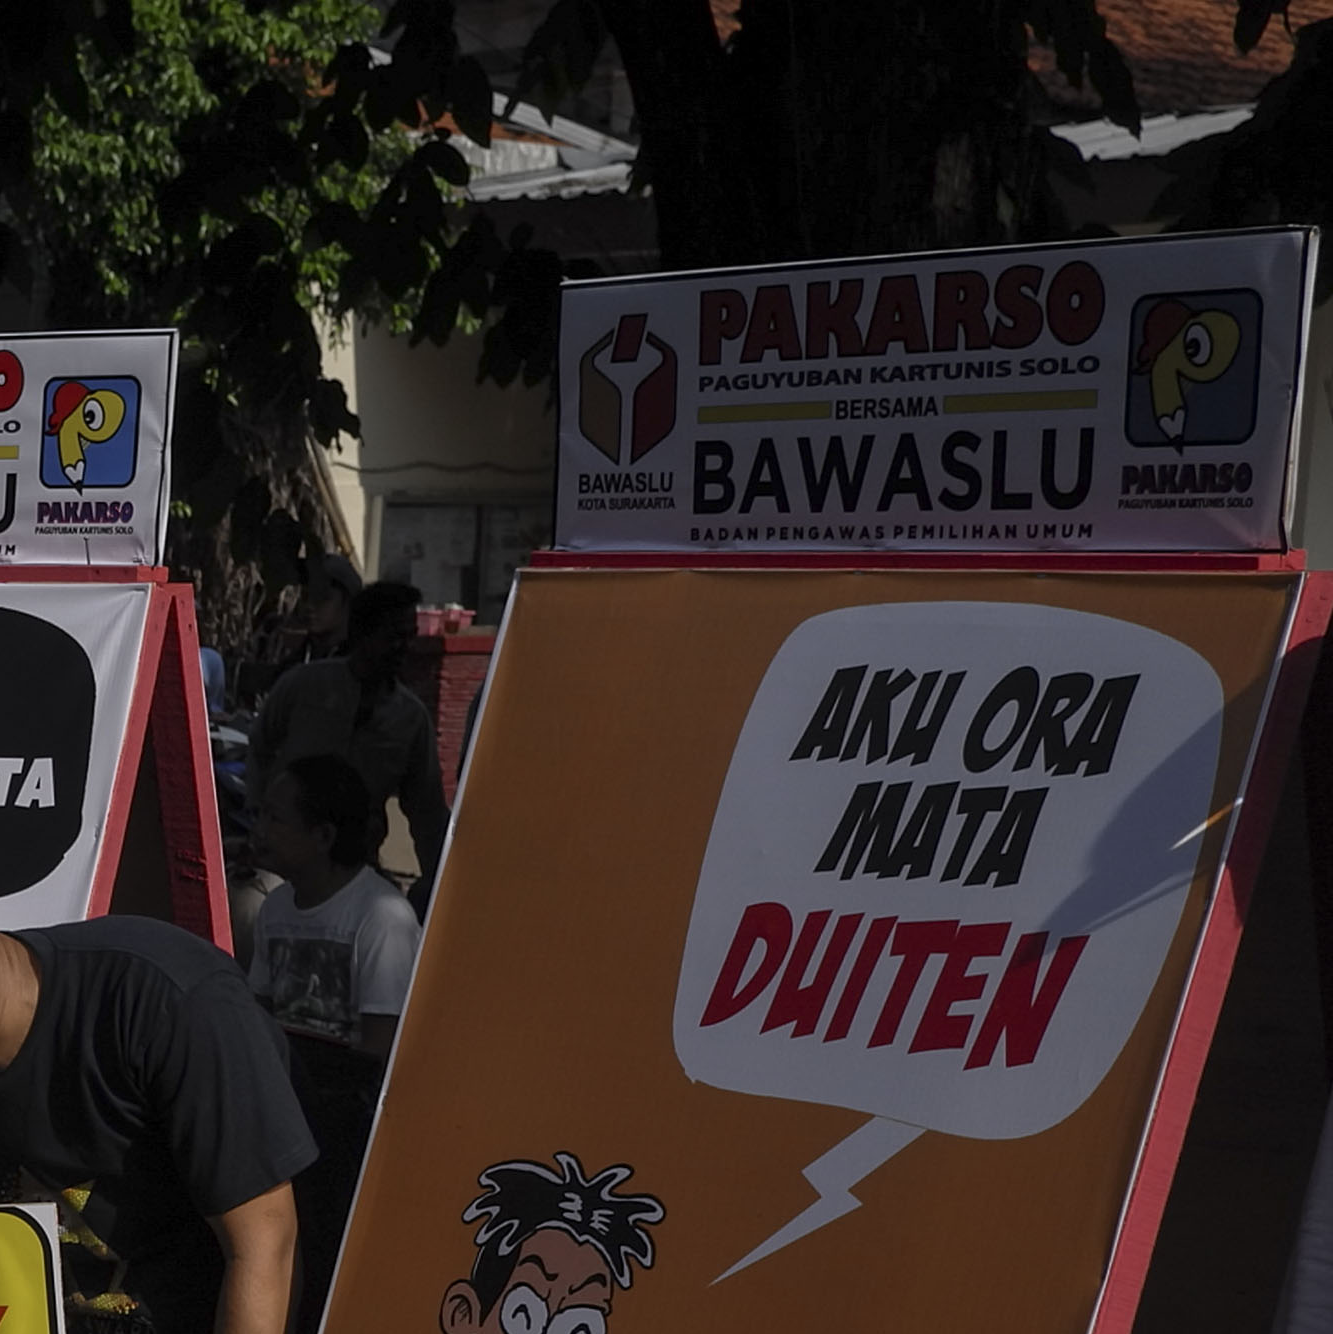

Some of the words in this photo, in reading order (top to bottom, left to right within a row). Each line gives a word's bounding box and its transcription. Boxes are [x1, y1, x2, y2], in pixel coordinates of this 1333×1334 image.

[699, 260, 1105, 365] PAKARSO
[699, 368, 862, 393] PAGUYUBAN
[870, 360, 1012, 384] KARTUNIS
[1019, 356, 1100, 377] SOLO
[835, 397, 939, 420] BERSAMA
[578, 472, 674, 494] BAWASLU
[693, 427, 1095, 515] BAWASLU
[1121, 462, 1253, 495] PAKARSO
[36, 501, 134, 524] PAKARSO
[577, 497, 607, 511] KOTA
[609, 497, 676, 511] SURAKARTA
[1226, 497, 1254, 508] SOLO
[34, 526, 79, 535] PAGUYUBAN
[79, 526, 114, 535] KARTUNIS
[114, 526, 134, 535] SOLO
[691, 528, 759, 541] BADAN
[766, 526, 885, 541] PENGAWAS
[893, 525, 1017, 539] PEMILIHAN
[1027, 524, 1093, 539] UMUM
[789, 664, 967, 767] AKU
[962, 665, 1140, 778] ORA
[814, 780, 1050, 889] MATA
[699, 901, 1091, 1072] DUITEN
